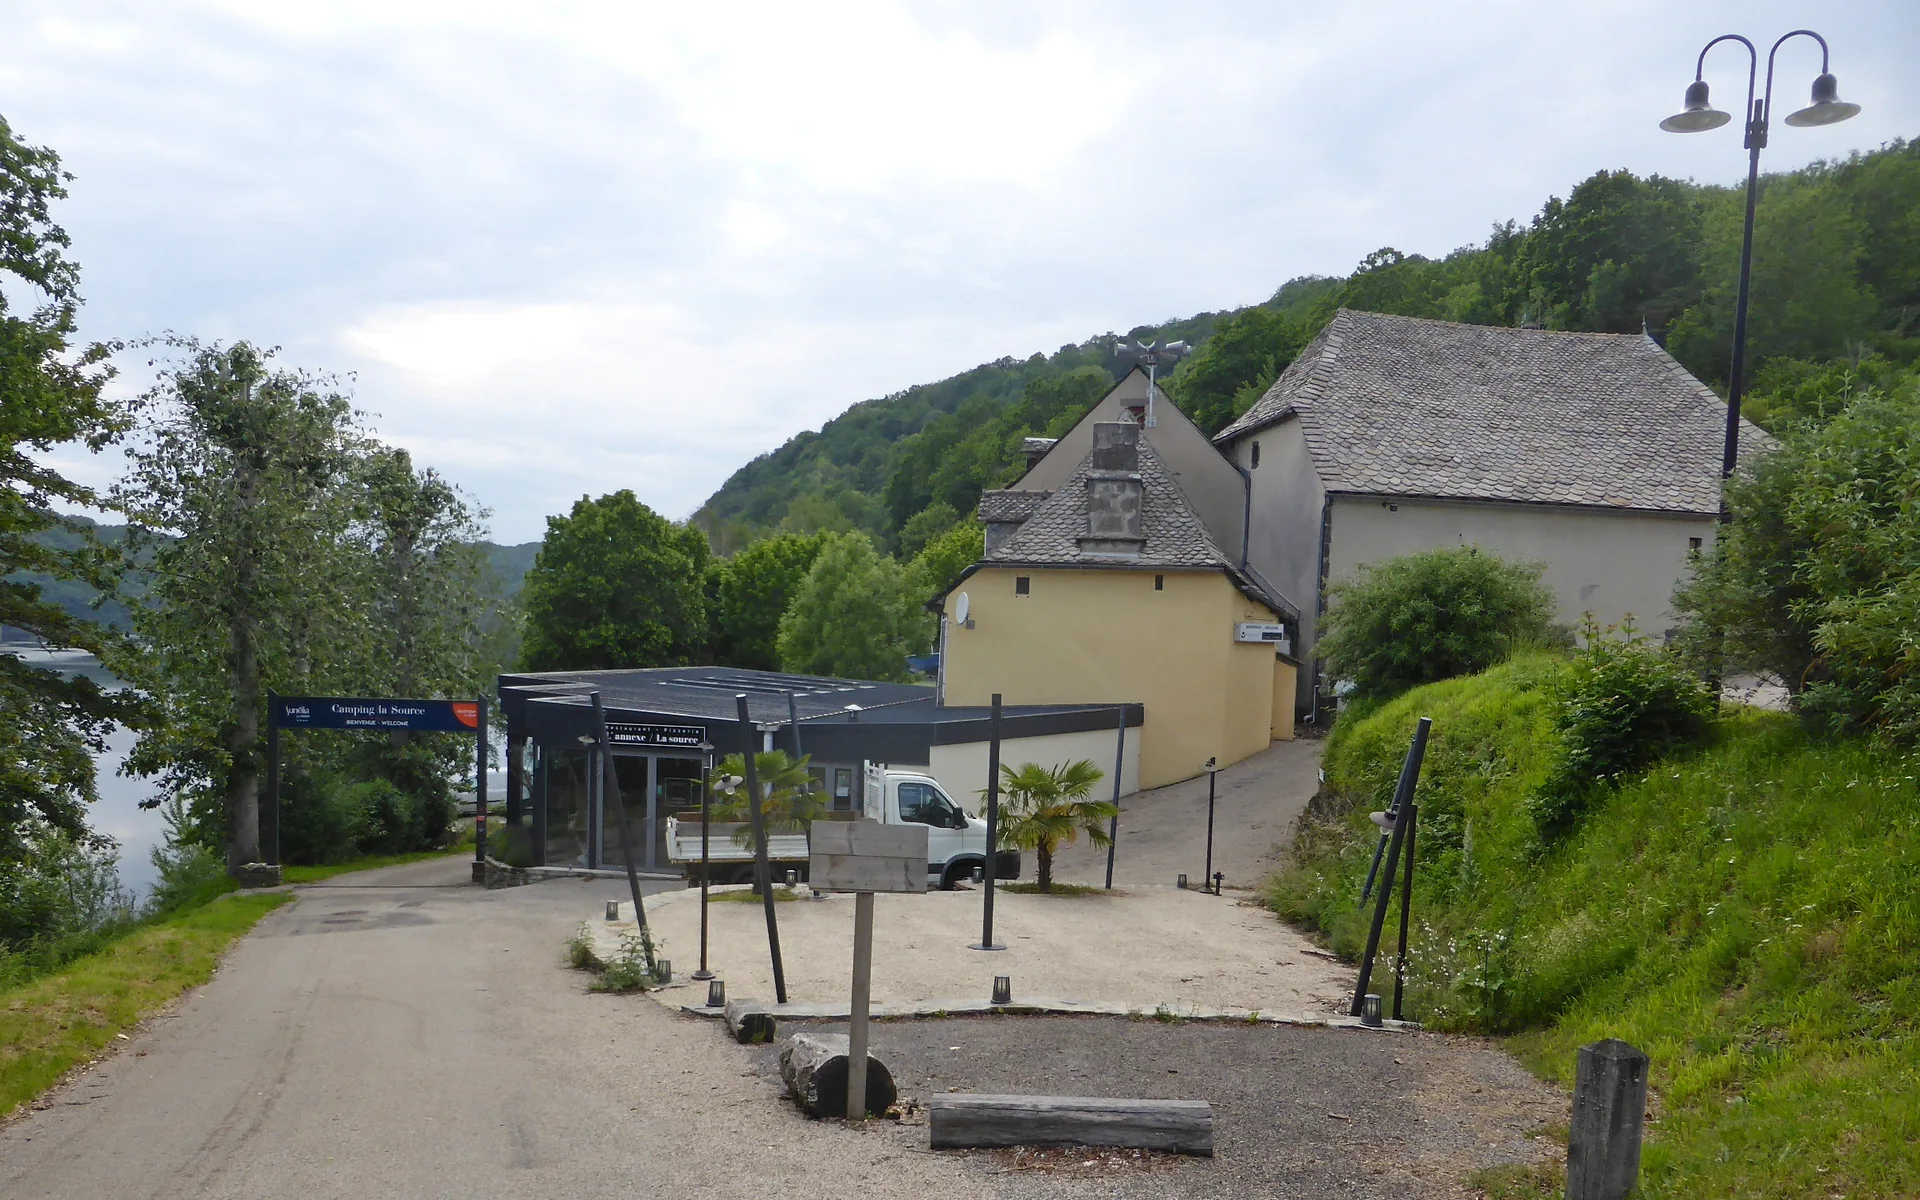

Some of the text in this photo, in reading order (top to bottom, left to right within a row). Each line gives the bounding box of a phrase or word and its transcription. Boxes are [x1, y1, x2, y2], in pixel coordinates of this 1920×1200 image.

[331, 703, 426, 717] Camping la Source
[614, 733, 646, 742] annexe
[656, 734, 667, 743] La
[668, 736, 699, 744] source
